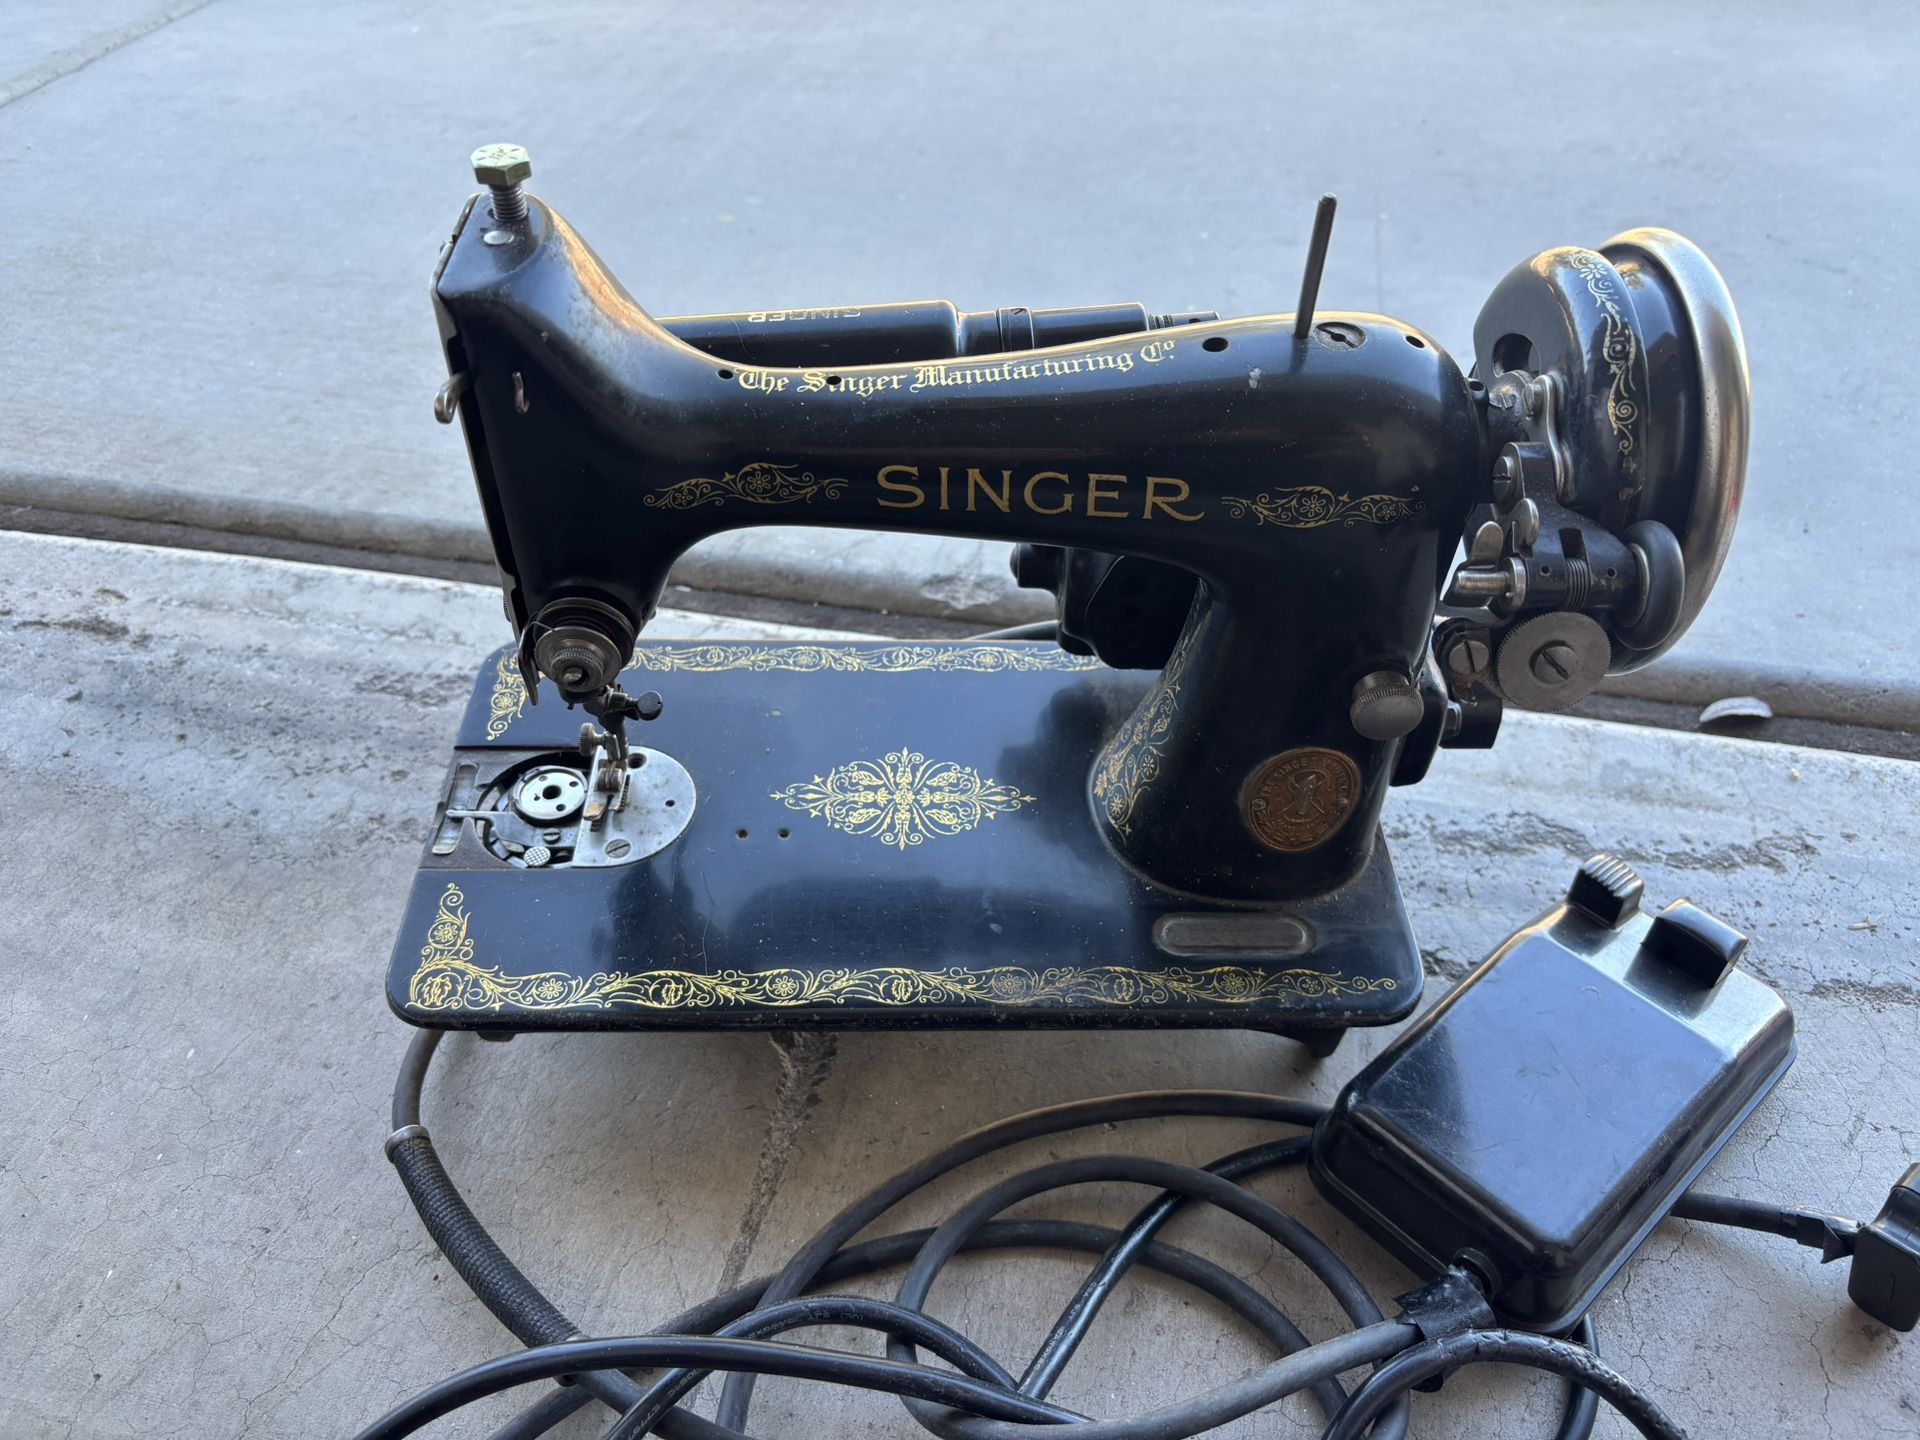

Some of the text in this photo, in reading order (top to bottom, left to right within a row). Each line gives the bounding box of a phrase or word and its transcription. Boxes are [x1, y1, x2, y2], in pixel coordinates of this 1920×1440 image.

[734, 368, 790, 395] The
[909, 351, 1135, 393] Manufacturing
[876, 464, 1206, 522] SINGER
